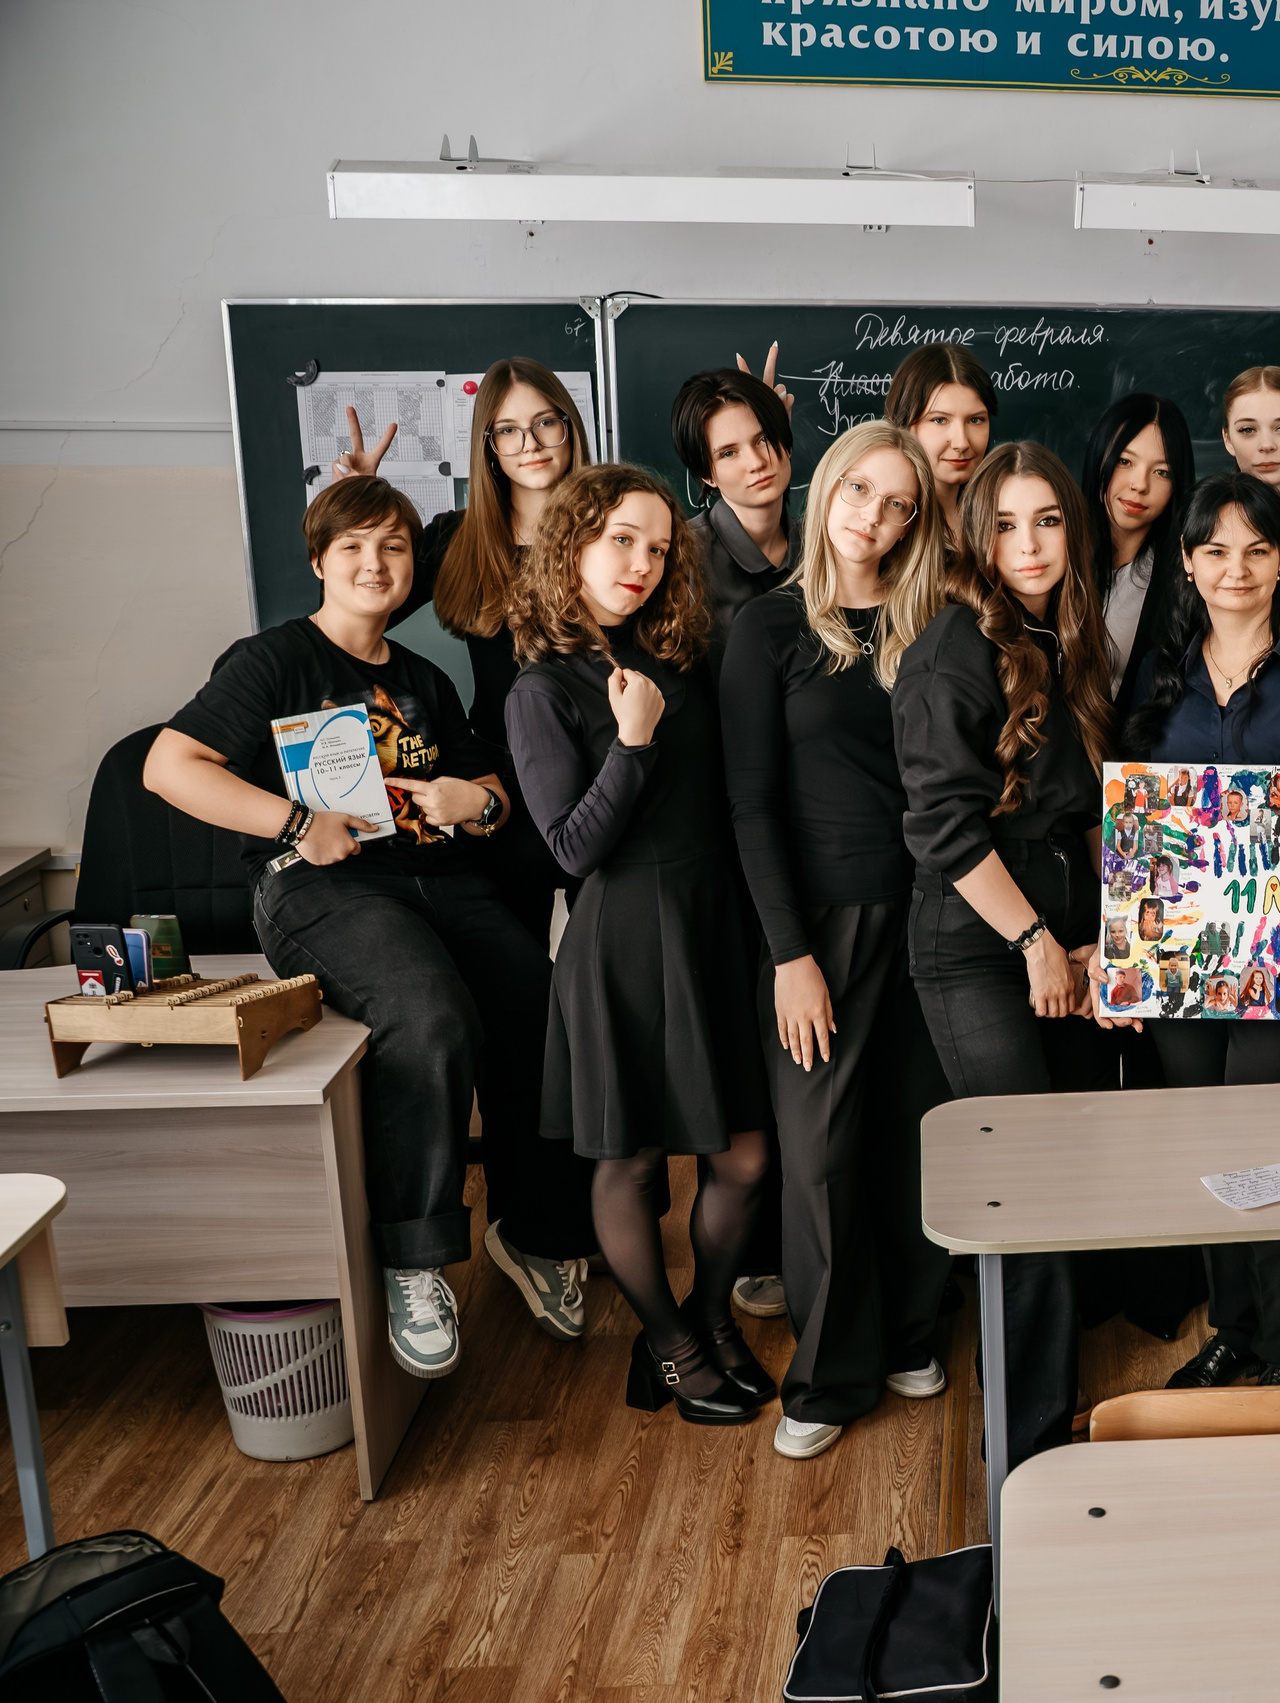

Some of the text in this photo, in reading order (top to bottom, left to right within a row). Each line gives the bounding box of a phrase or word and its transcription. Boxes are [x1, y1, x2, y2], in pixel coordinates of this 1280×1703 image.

[761, 20, 1230, 63] красотою и силою.
[854, 312, 976, 351] Девятое
[991, 362, 1081, 391] абота.
[398, 734, 425, 752] THE
[314, 752, 366, 768] РУССКИЙ ЯЗЫК
[338, 762, 361, 770] классы
